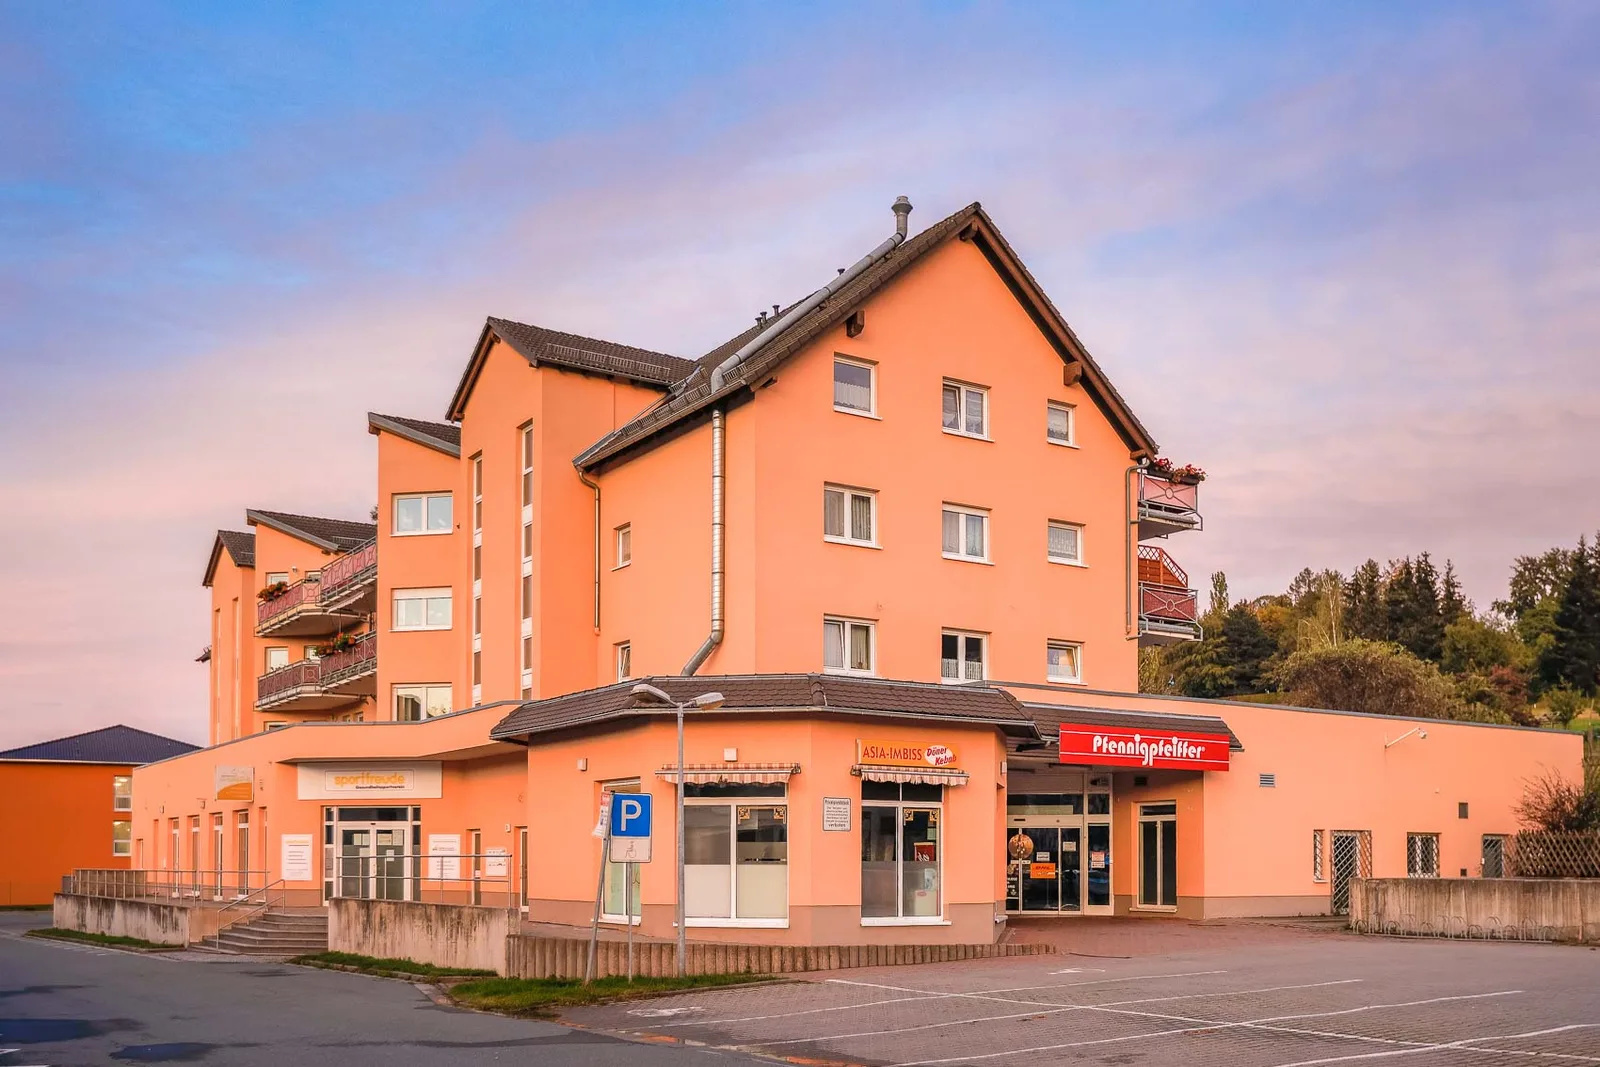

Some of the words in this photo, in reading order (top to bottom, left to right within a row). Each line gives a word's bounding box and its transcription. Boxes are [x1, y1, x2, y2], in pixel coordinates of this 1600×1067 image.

[862, 745, 922, 761] ASIA-IMBISS
[926, 747, 947, 757] Döner
[1092, 734, 1203, 767] Pfennigpfeiffer
[935, 754, 957, 766] Kebab
[334, 772, 405, 788] sportfreude
[620, 799, 642, 832] P
